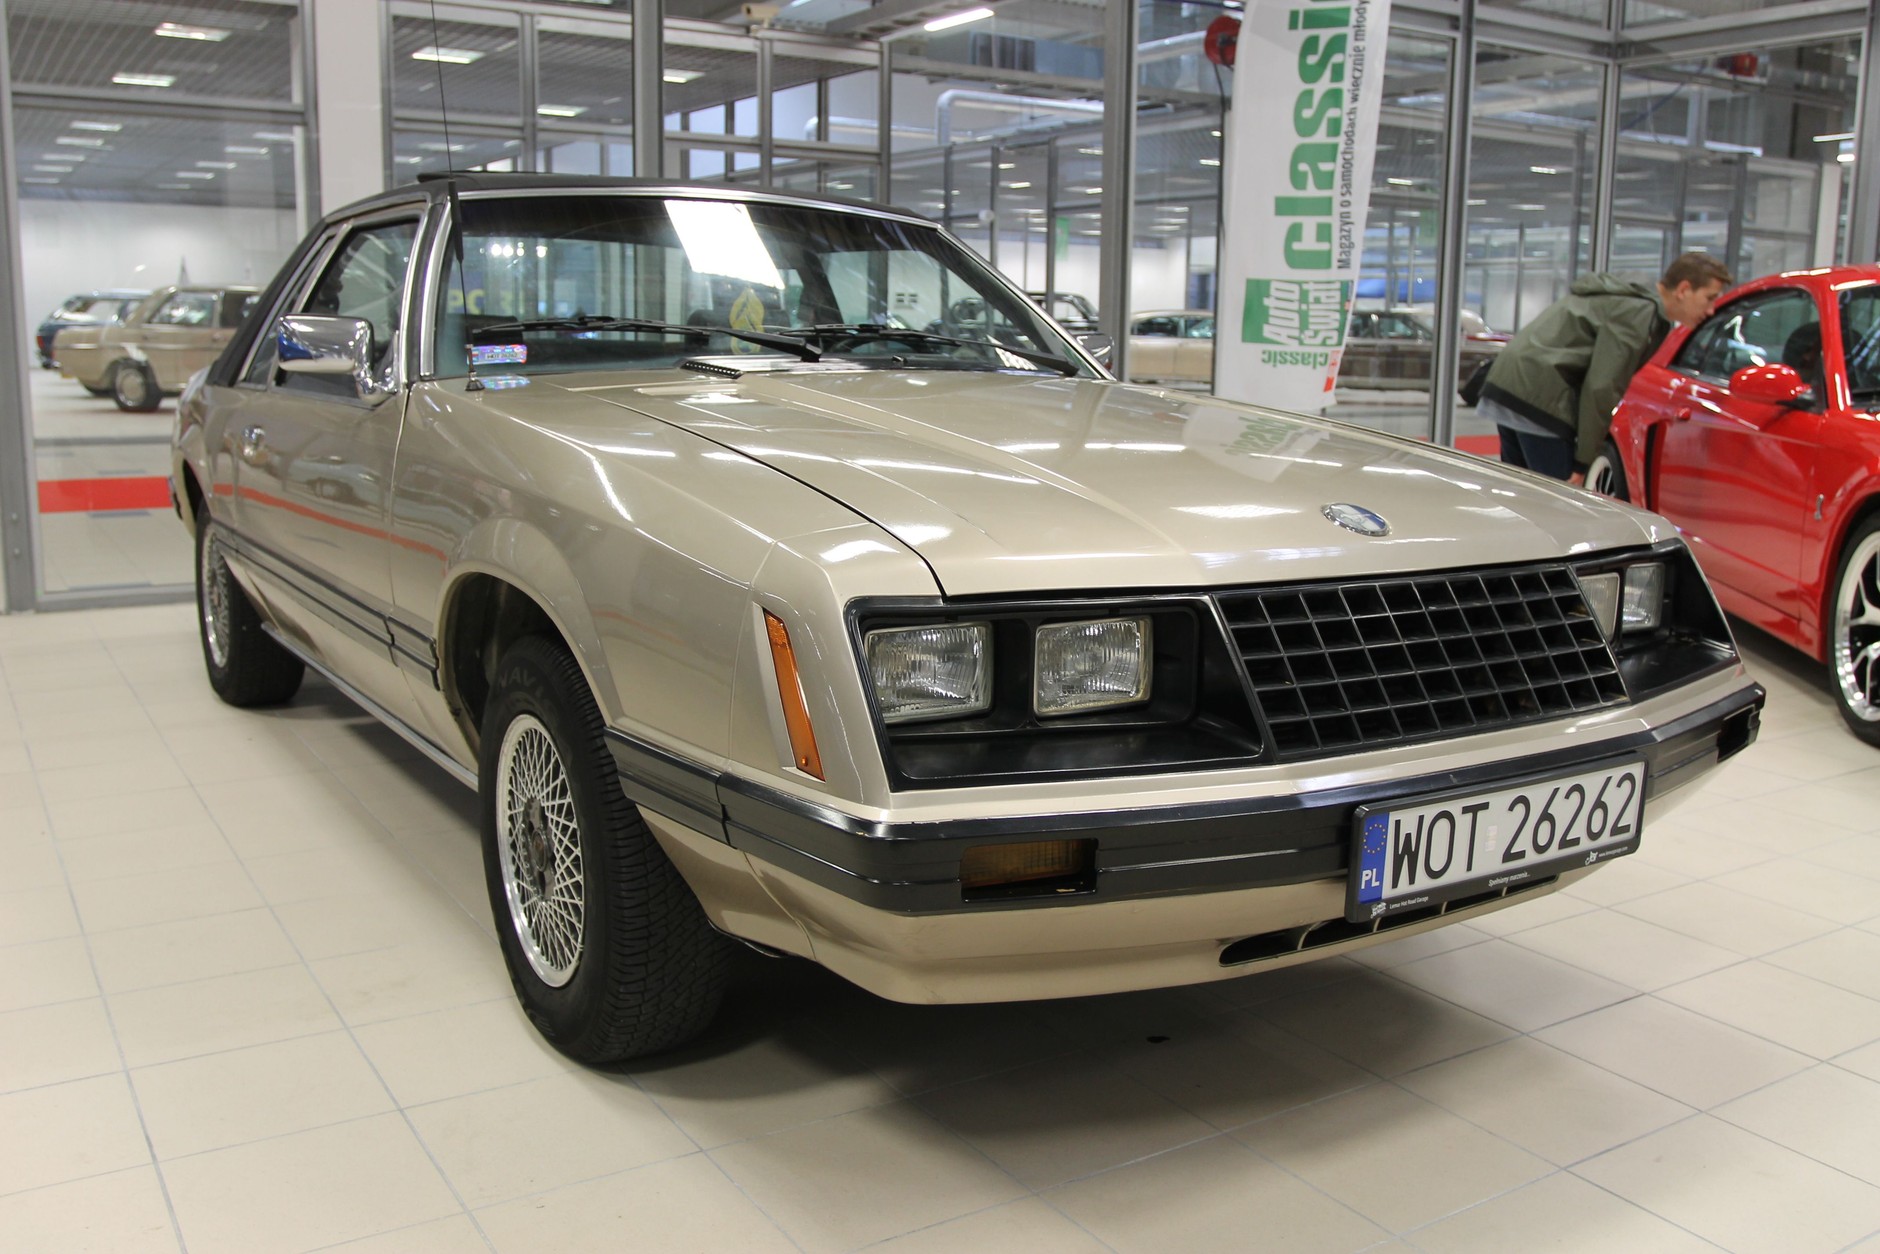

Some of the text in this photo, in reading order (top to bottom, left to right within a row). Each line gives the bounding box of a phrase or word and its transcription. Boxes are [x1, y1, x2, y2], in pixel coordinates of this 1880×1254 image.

[1347, 44, 1366, 104] wiecznie
[1275, 0, 1351, 269] classi
[1340, 105, 1358, 197] samochodach
[1339, 199, 1352, 209] o
[1337, 211, 1355, 270] Magazyn
[1263, 279, 1301, 346] Auto
[1300, 280, 1342, 346] Świat
[1261, 349, 1329, 369] classic
[1391, 772, 1636, 889] WOT 26262
[1361, 868, 1380, 890] PL
